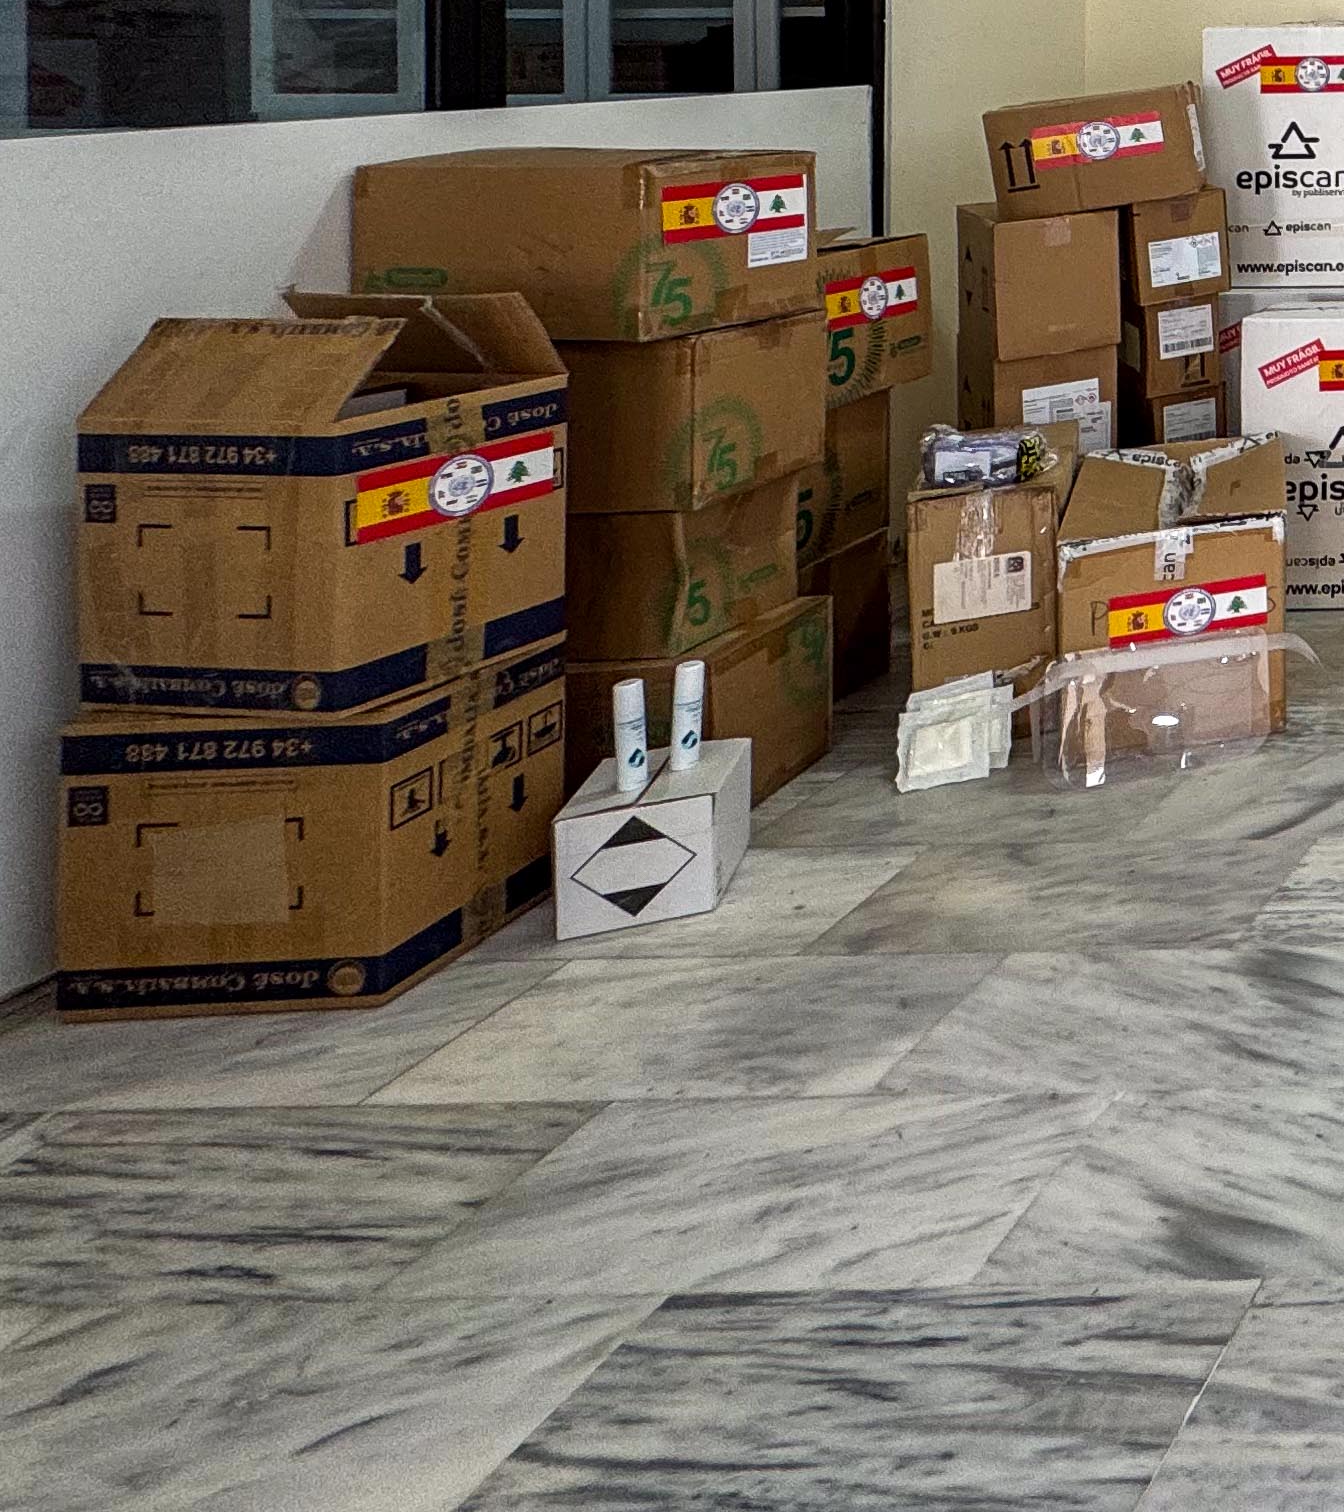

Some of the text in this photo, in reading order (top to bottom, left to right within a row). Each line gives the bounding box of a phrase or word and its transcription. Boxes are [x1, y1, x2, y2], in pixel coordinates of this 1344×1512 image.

[1220, 62, 1241, 79] MUY
[1285, 221, 1332, 233] episcan
[826, 329, 857, 387] 5
[1264, 343, 1322, 378] MUY FRÁGIL
[166, 446, 201, 465] 871
[204, 446, 239, 465] 972
[243, 446, 279, 466] +34
[1132, 453, 1182, 468] episca
[178, 740, 217, 760] 871
[224, 740, 266, 759] 972
[272, 739, 314, 759] +34
[253, 969, 320, 990] JOSÉ
